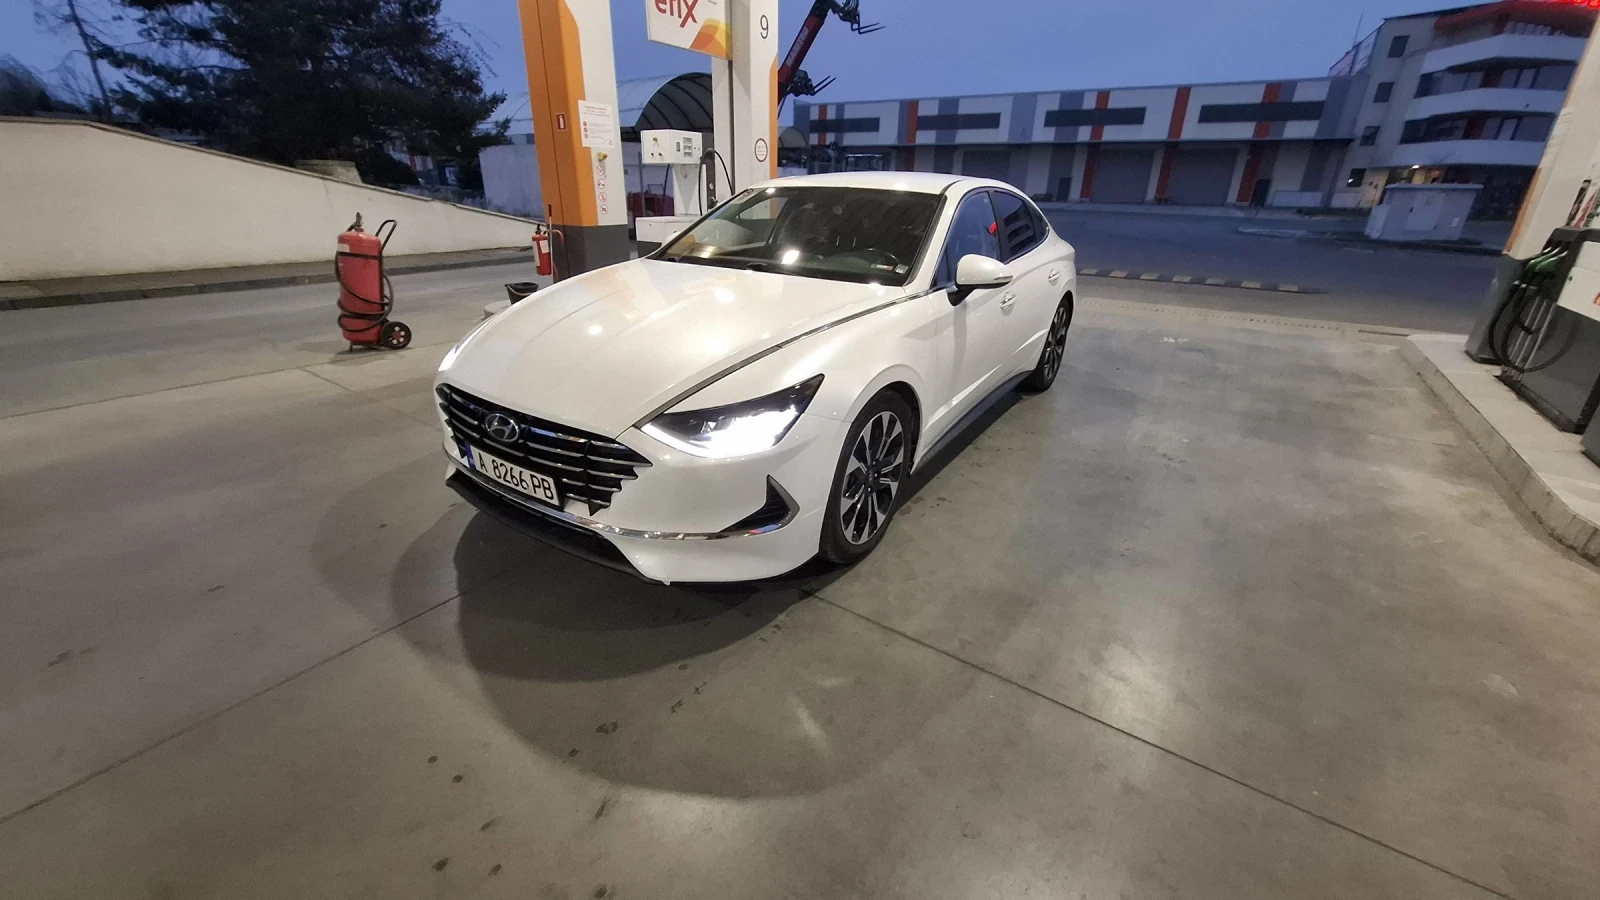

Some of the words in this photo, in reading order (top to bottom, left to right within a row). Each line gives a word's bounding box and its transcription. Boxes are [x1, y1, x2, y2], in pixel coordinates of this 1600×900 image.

[760, 14, 769, 40] 9
[478, 452, 488, 473] A
[492, 459, 529, 490] 8266
[529, 473, 554, 500] PB
